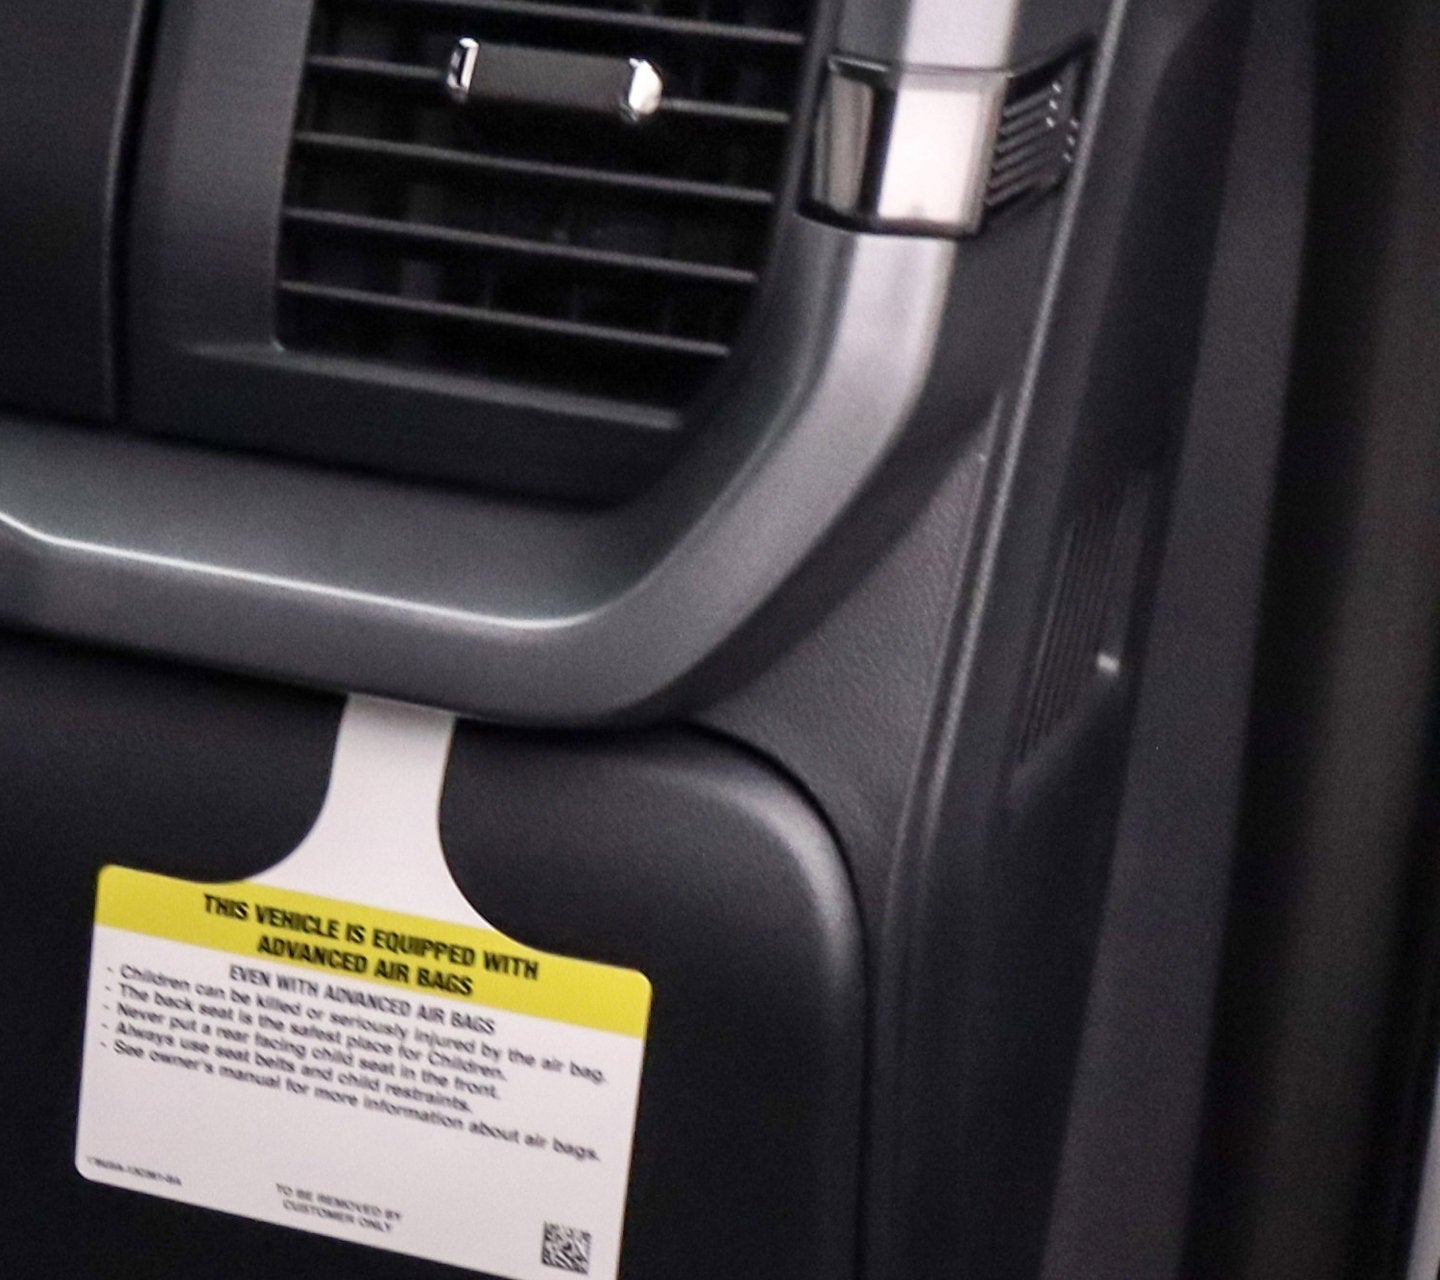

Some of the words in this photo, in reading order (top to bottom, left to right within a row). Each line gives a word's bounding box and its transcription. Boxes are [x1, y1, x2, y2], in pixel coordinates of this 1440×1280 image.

[204, 894, 248, 920] THIS
[255, 903, 339, 939] VEHICLE
[346, 922, 366, 944] IS
[373, 928, 476, 966] EQUIPPED
[483, 950, 540, 980] WITH
[258, 935, 368, 974] ADVANCED
[375, 959, 410, 984] AIR
[417, 967, 474, 996] BAGS
[118, 982, 150, 1002] The
[153, 990, 194, 1012] back
[197, 1003, 233, 1022] seat
[238, 1008, 253, 1025] is
[258, 1012, 285, 1031] the
[289, 1022, 342, 1046] safest
[345, 1035, 393, 1057] place
[398, 1043, 422, 1061] for
[120, 964, 191, 992] Children
[195, 982, 225, 1000] can
[229, 987, 251, 1006] be
[256, 992, 302, 1017] killed
[306, 1006, 324, 1021] or
[329, 1012, 408, 1041] seriously
[414, 1026, 476, 1054] injured
[480, 1041, 502, 1062] by
[508, 1047, 535, 1067] the
[541, 1056, 564, 1073] air
[570, 1060, 608, 1086] bag.
[230, 964, 271, 988] EVEN
[276, 973, 319, 998] WITH
[323, 984, 411, 1018] ADVANCED
[417, 1004, 446, 1024] AIR
[450, 1010, 496, 1035] BAGS
[115, 1020, 174, 1047] Always
[179, 1036, 210, 1054] use
[214, 1045, 250, 1064] seat
[254, 1052, 296, 1072] belts
[300, 1065, 333, 1082] and
[337, 1071, 380, 1093] child
[117, 1002, 164, 1024] Never
[168, 1015, 197, 1033] put
[201, 1023, 211, 1036] a
[216, 1025, 250, 1045] rear
[254, 1030, 307, 1060] facing
[311, 1045, 354, 1067] child
[359, 1056, 395, 1077] seat
[400, 1062, 416, 1080] in
[421, 1068, 449, 1088] the
[113, 1038, 145, 1058] See
[148, 1049, 215, 1075] owner's
[218, 1064, 281, 1089] manual
[285, 1077, 310, 1096] for
[314, 1085, 359, 1107] more
[363, 1095, 464, 1130] information
[468, 1121, 520, 1145] about
[524, 1133, 549, 1149] air
[276, 1183, 293, 1197] TO
[296, 1189, 312, 1202] BE
[317, 1192, 381, 1218] REMOVED
[282, 1199, 355, 1223] CUSTOMER
[360, 1217, 392, 1233] ONLY
